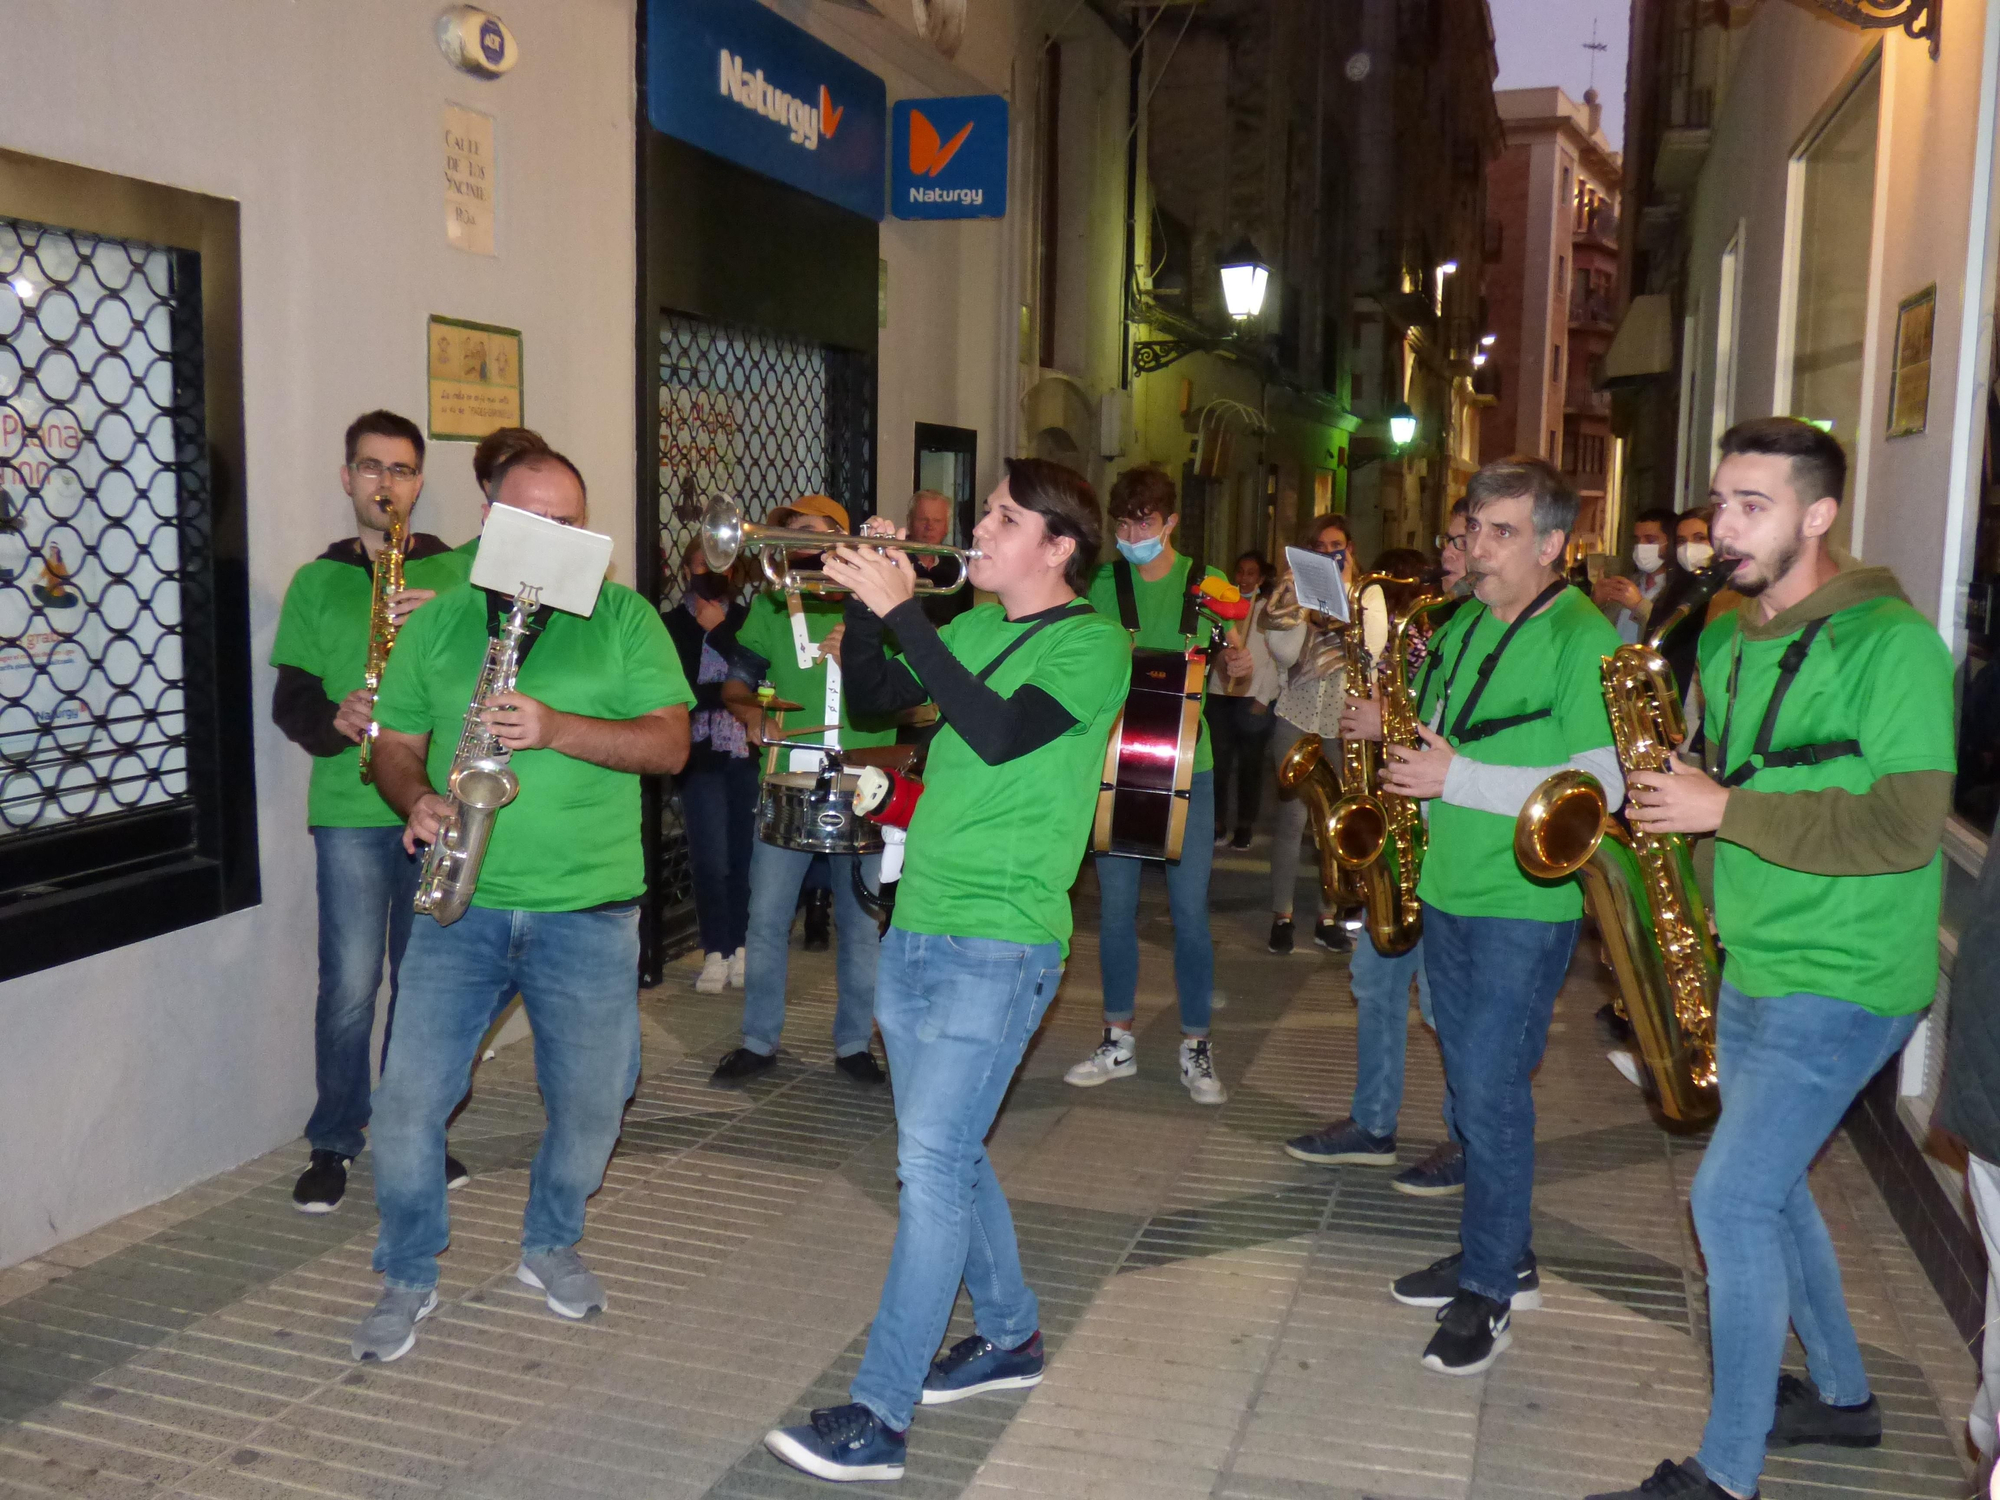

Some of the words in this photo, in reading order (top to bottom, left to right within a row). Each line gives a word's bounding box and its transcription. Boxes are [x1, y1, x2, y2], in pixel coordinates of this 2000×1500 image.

[484, 33, 502, 52] ADT
[720, 48, 818, 150] Naturgy
[909, 187, 983, 205] Naturgy
[35, 709, 79, 720] Naurgy
